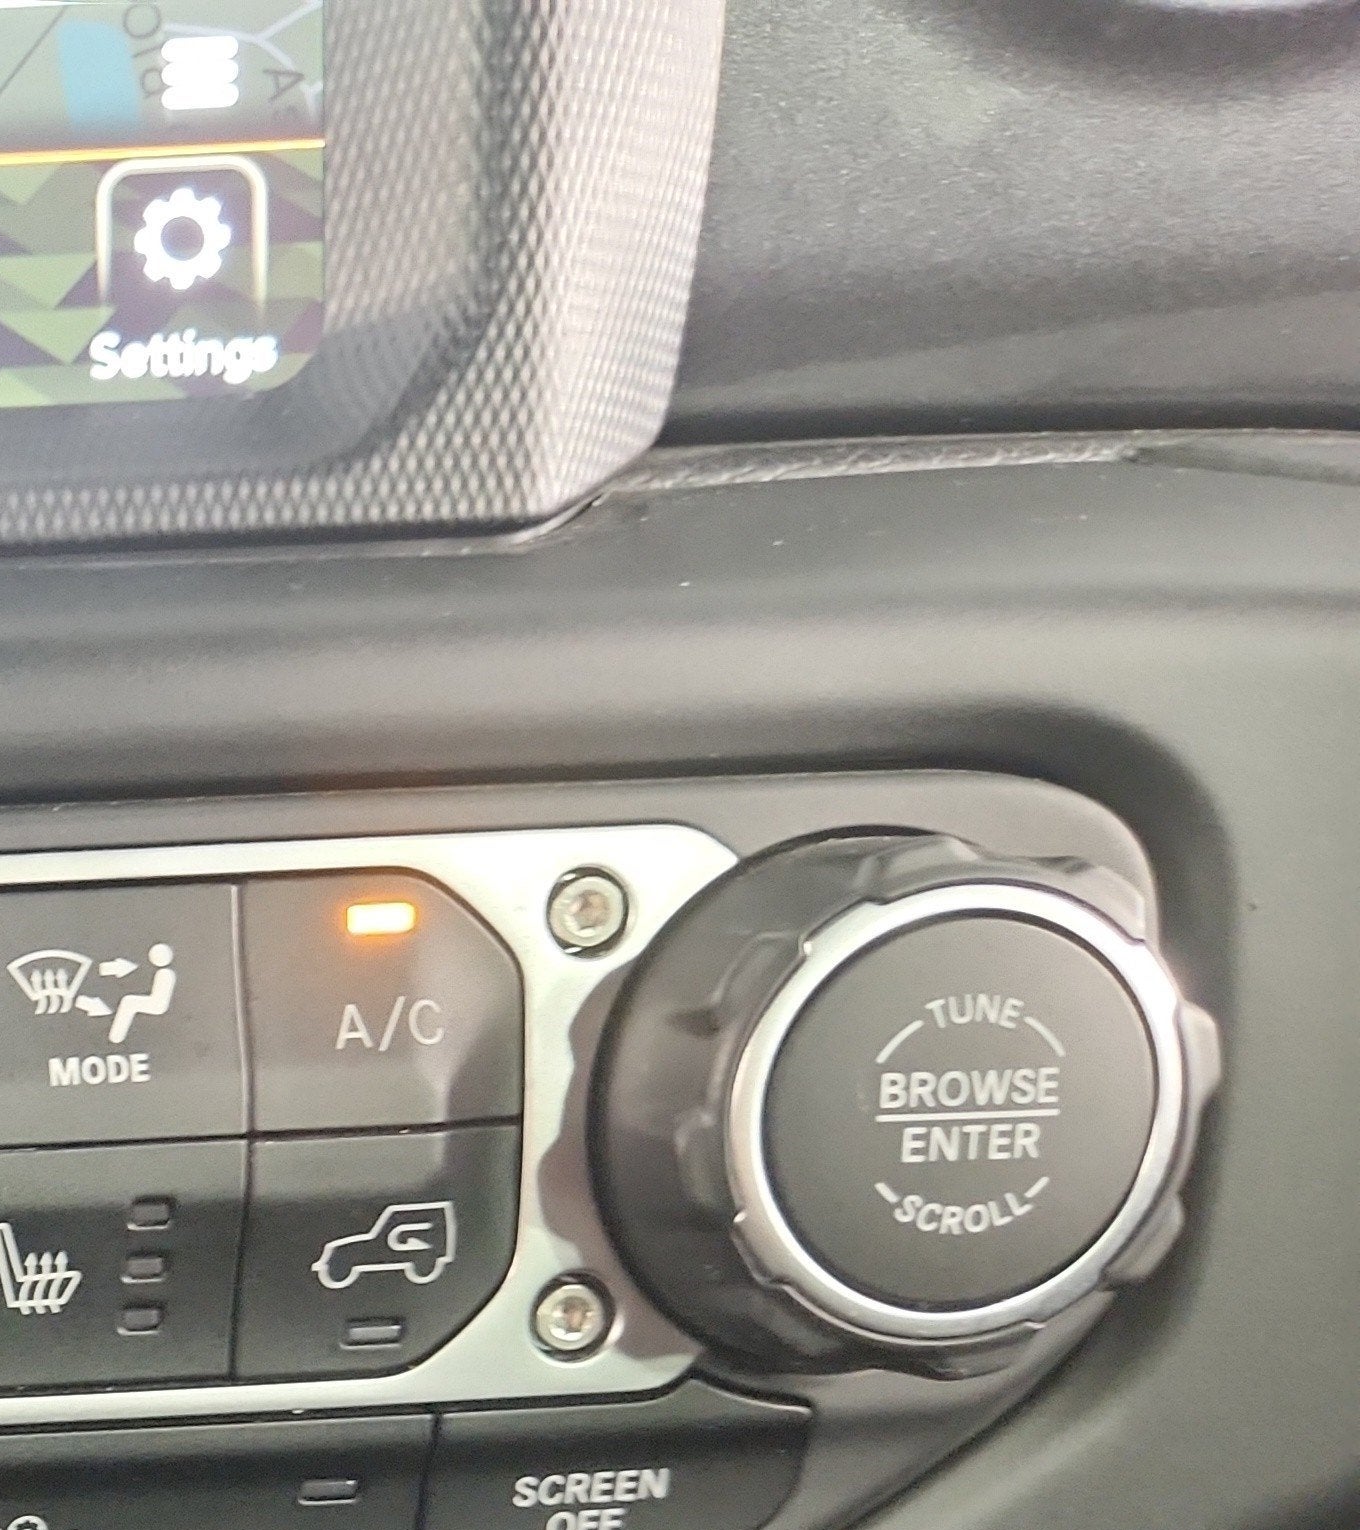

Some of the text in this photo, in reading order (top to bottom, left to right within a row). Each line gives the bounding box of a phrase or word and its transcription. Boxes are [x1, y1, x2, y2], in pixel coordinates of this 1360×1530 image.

[90, 329, 278, 385] Settings
[335, 996, 444, 1051] A/C
[925, 993, 1025, 1030] TUNE
[49, 1053, 151, 1087] MODE
[879, 1066, 1059, 1109] BROWSE
[900, 1122, 1040, 1163] ENTER
[893, 1191, 1034, 1236] SCROLL
[512, 1467, 670, 1509] SCREEN
